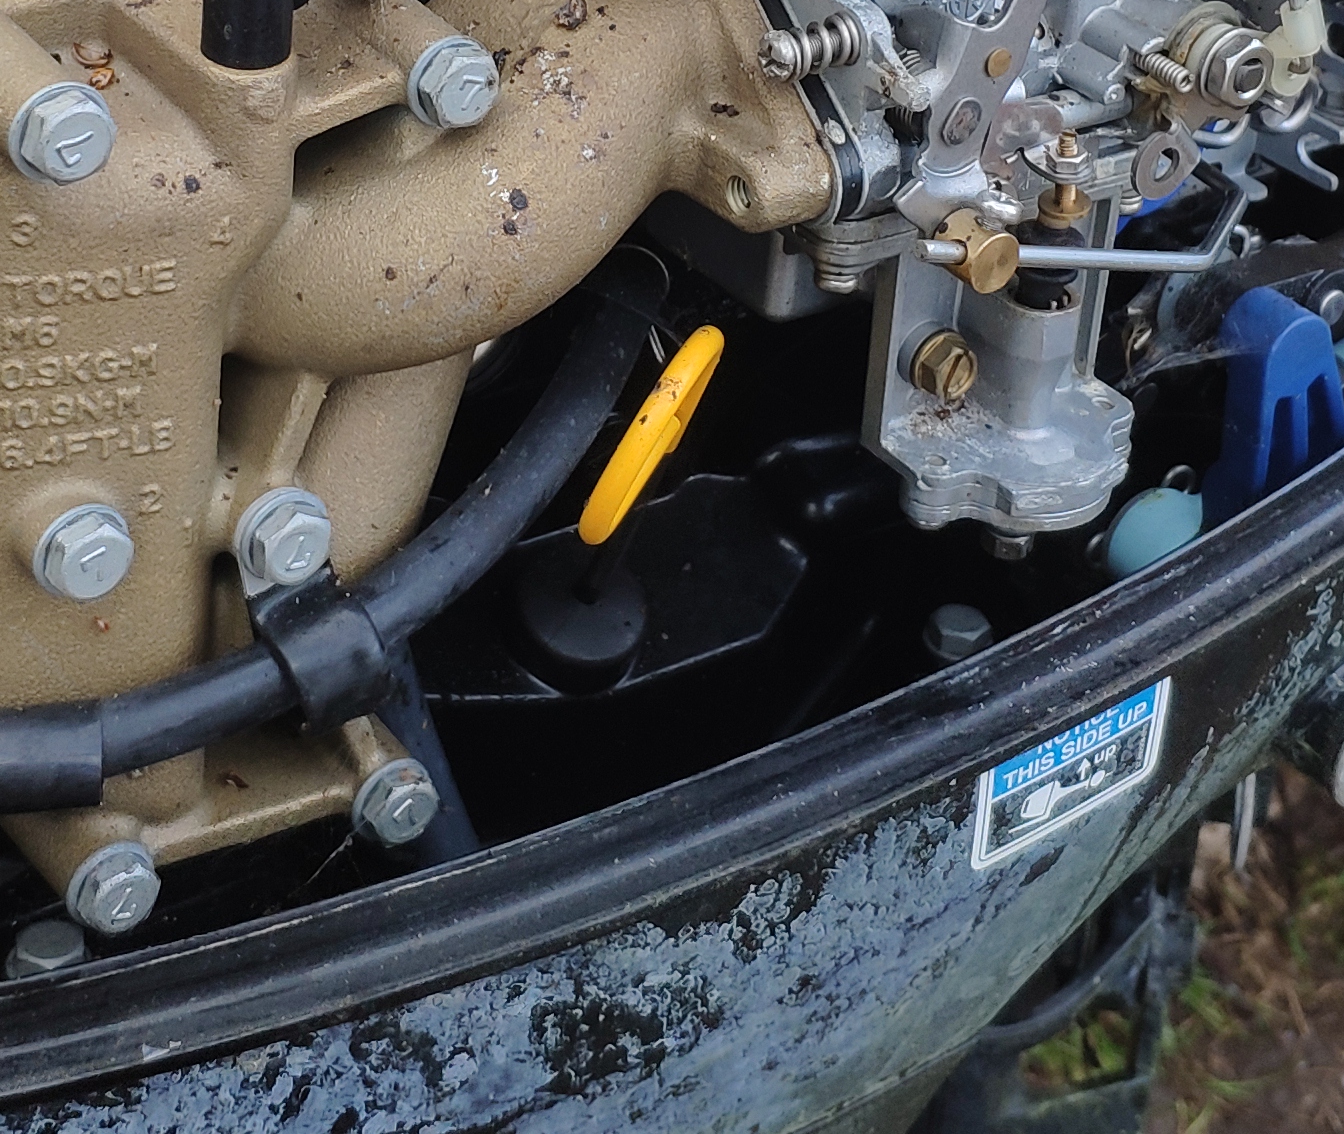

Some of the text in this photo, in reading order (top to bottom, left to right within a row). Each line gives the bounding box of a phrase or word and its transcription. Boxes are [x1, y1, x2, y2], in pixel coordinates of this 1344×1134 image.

[9, 212, 42, 248] 3
[0, 258, 178, 307] TORQUE
[1003, 751, 1055, 789] THIS
[1061, 720, 1113, 761] SIDE
[1117, 701, 1148, 729] UP
